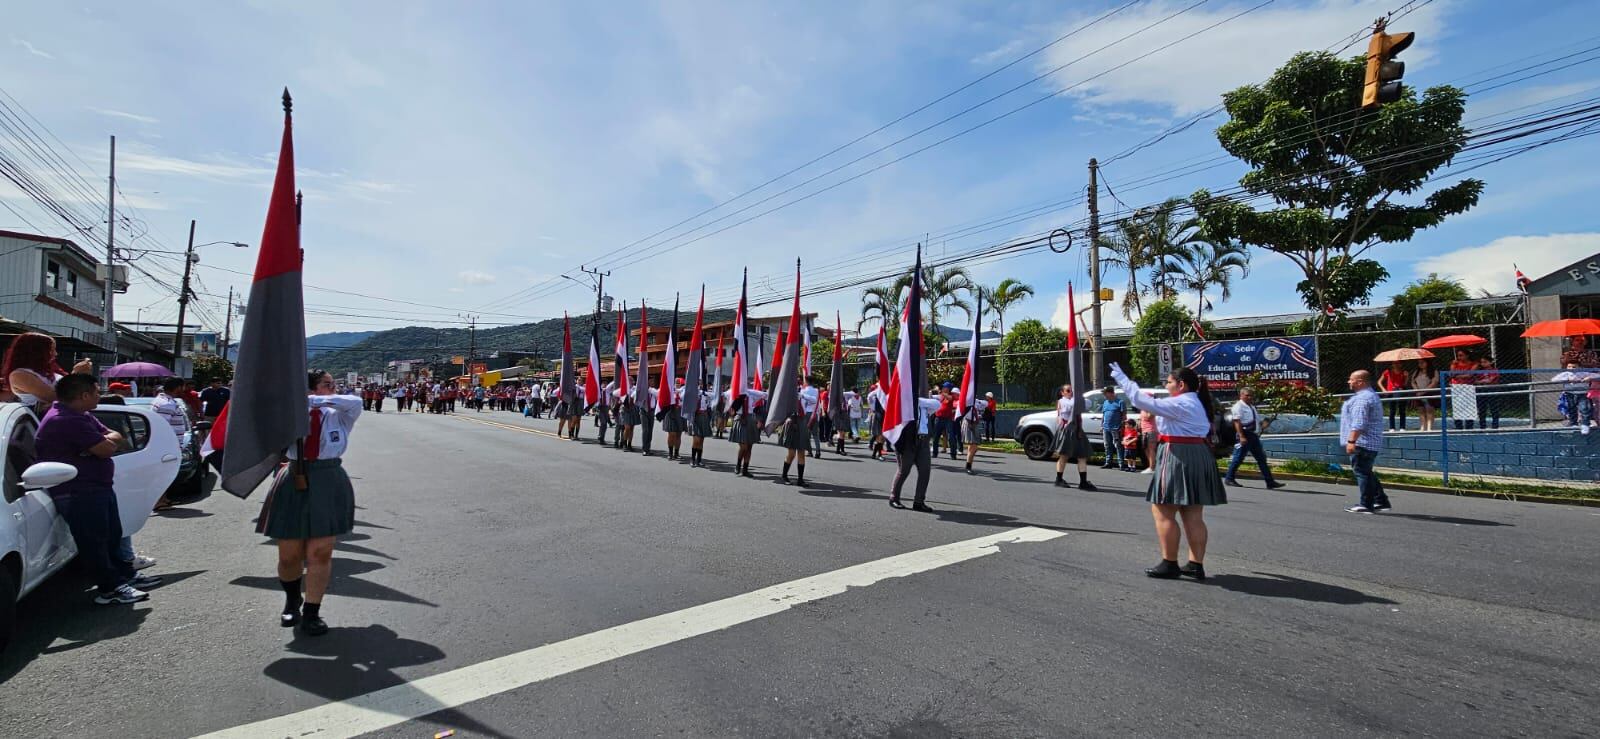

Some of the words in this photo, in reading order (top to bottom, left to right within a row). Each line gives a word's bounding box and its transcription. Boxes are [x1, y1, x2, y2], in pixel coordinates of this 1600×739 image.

[1234, 345, 1255, 353] Sede
[1208, 363, 1252, 372] Educación
[1254, 363, 1288, 371] Abierta
